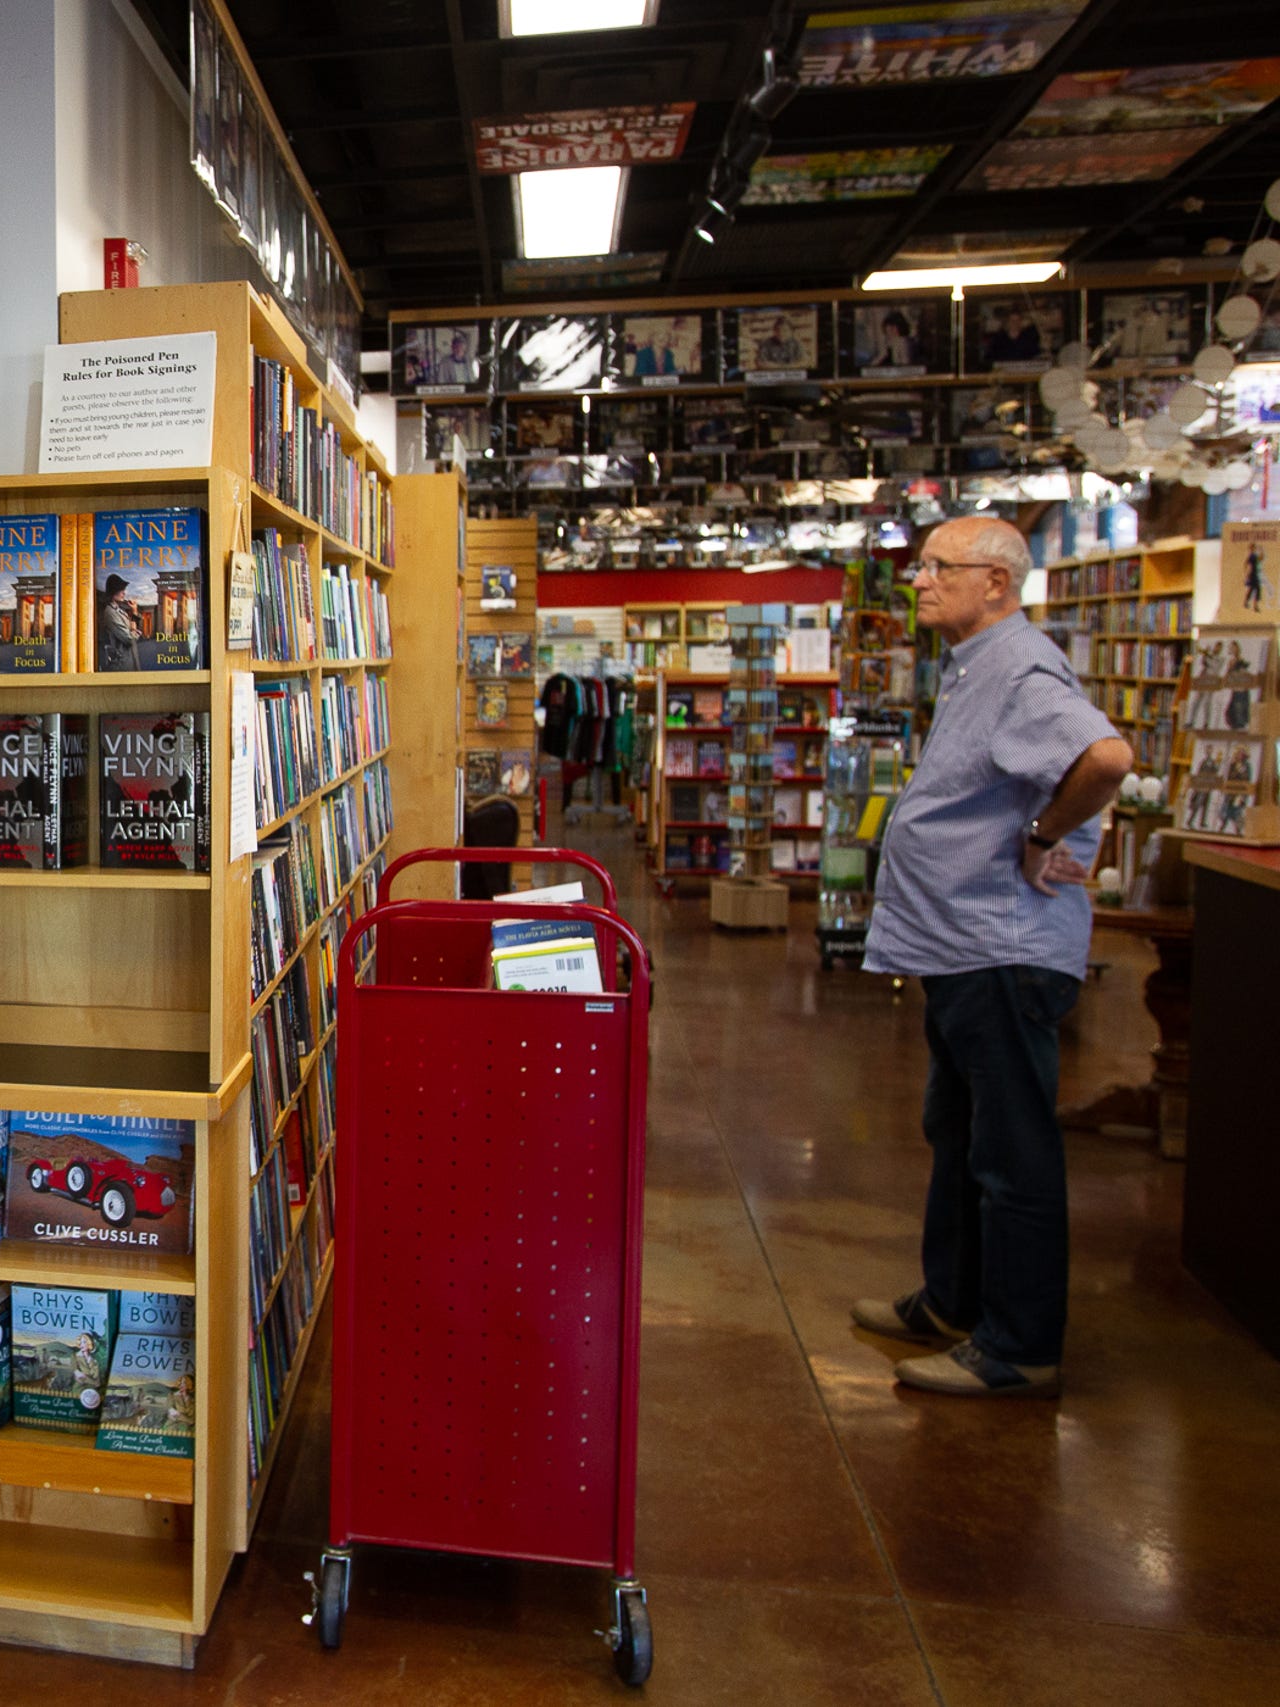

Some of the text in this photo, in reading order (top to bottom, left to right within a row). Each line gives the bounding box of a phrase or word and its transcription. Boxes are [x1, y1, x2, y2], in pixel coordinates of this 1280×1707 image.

[800, 40, 1035, 75] WHITE
[480, 120, 624, 140] LANSDALE
[482, 138, 676, 169] PARADISE
[80, 351, 179, 368] The Poisoned Pen
[63, 364, 198, 382] Rules for Book Signings
[102, 520, 189, 544] ANNE
[100, 544, 194, 571] PERRY
[155, 630, 192, 646] Death
[156, 652, 192, 666] Focus
[34, 1222, 160, 1247] CLIVE CUSSLER
[32, 1291, 84, 1311] RHYS
[22, 1309, 96, 1331] BOWEN
